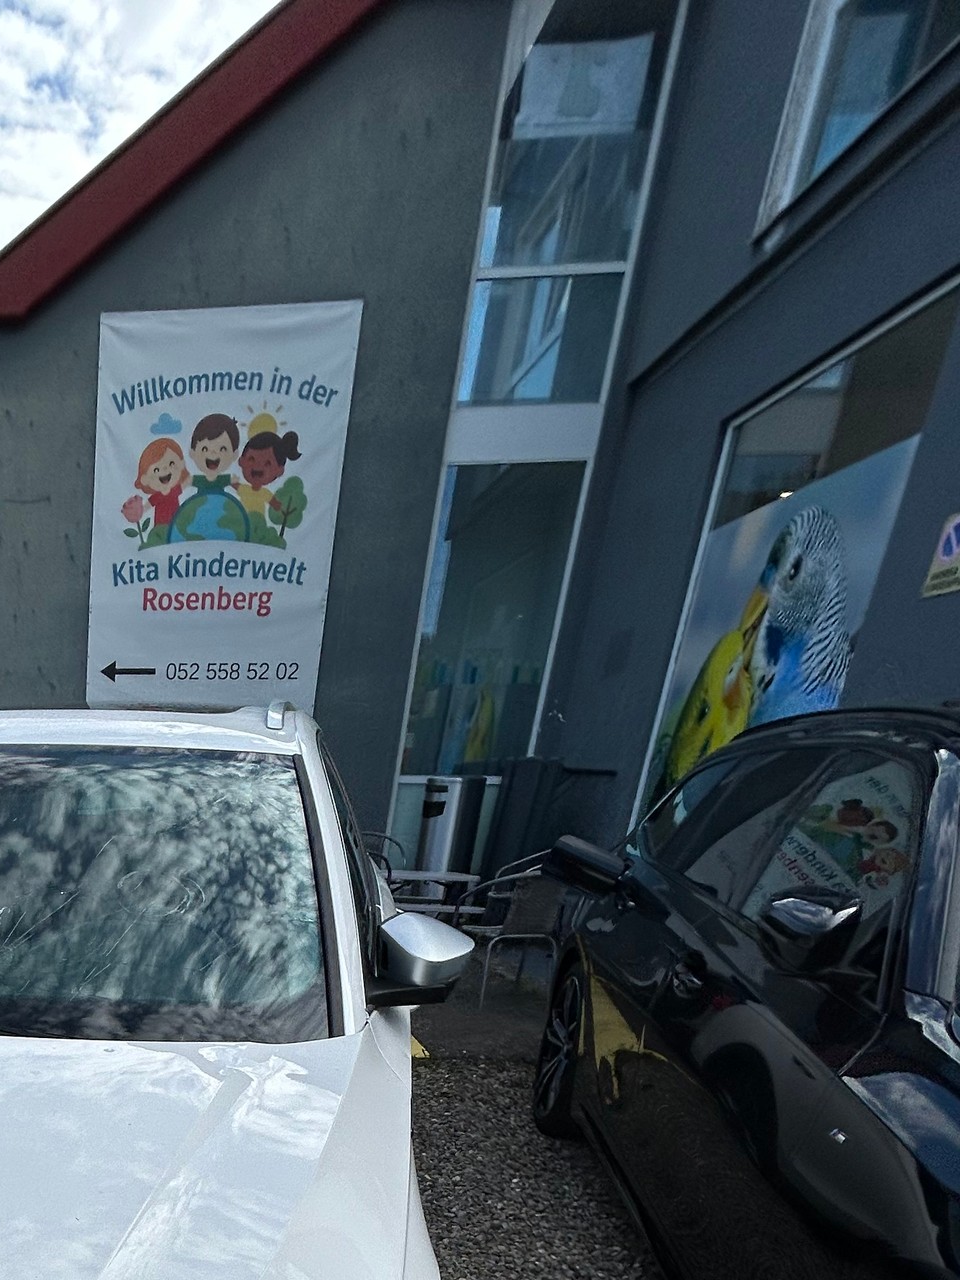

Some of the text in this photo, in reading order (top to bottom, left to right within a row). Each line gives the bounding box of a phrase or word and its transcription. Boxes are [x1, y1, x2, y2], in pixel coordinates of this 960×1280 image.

[111, 366, 339, 416] Willkommen in der
[111, 551, 308, 587] Kita Kinderwelt
[142, 586, 274, 617] Rosenberg
[166, 662, 299, 681] 052 558 52 02
